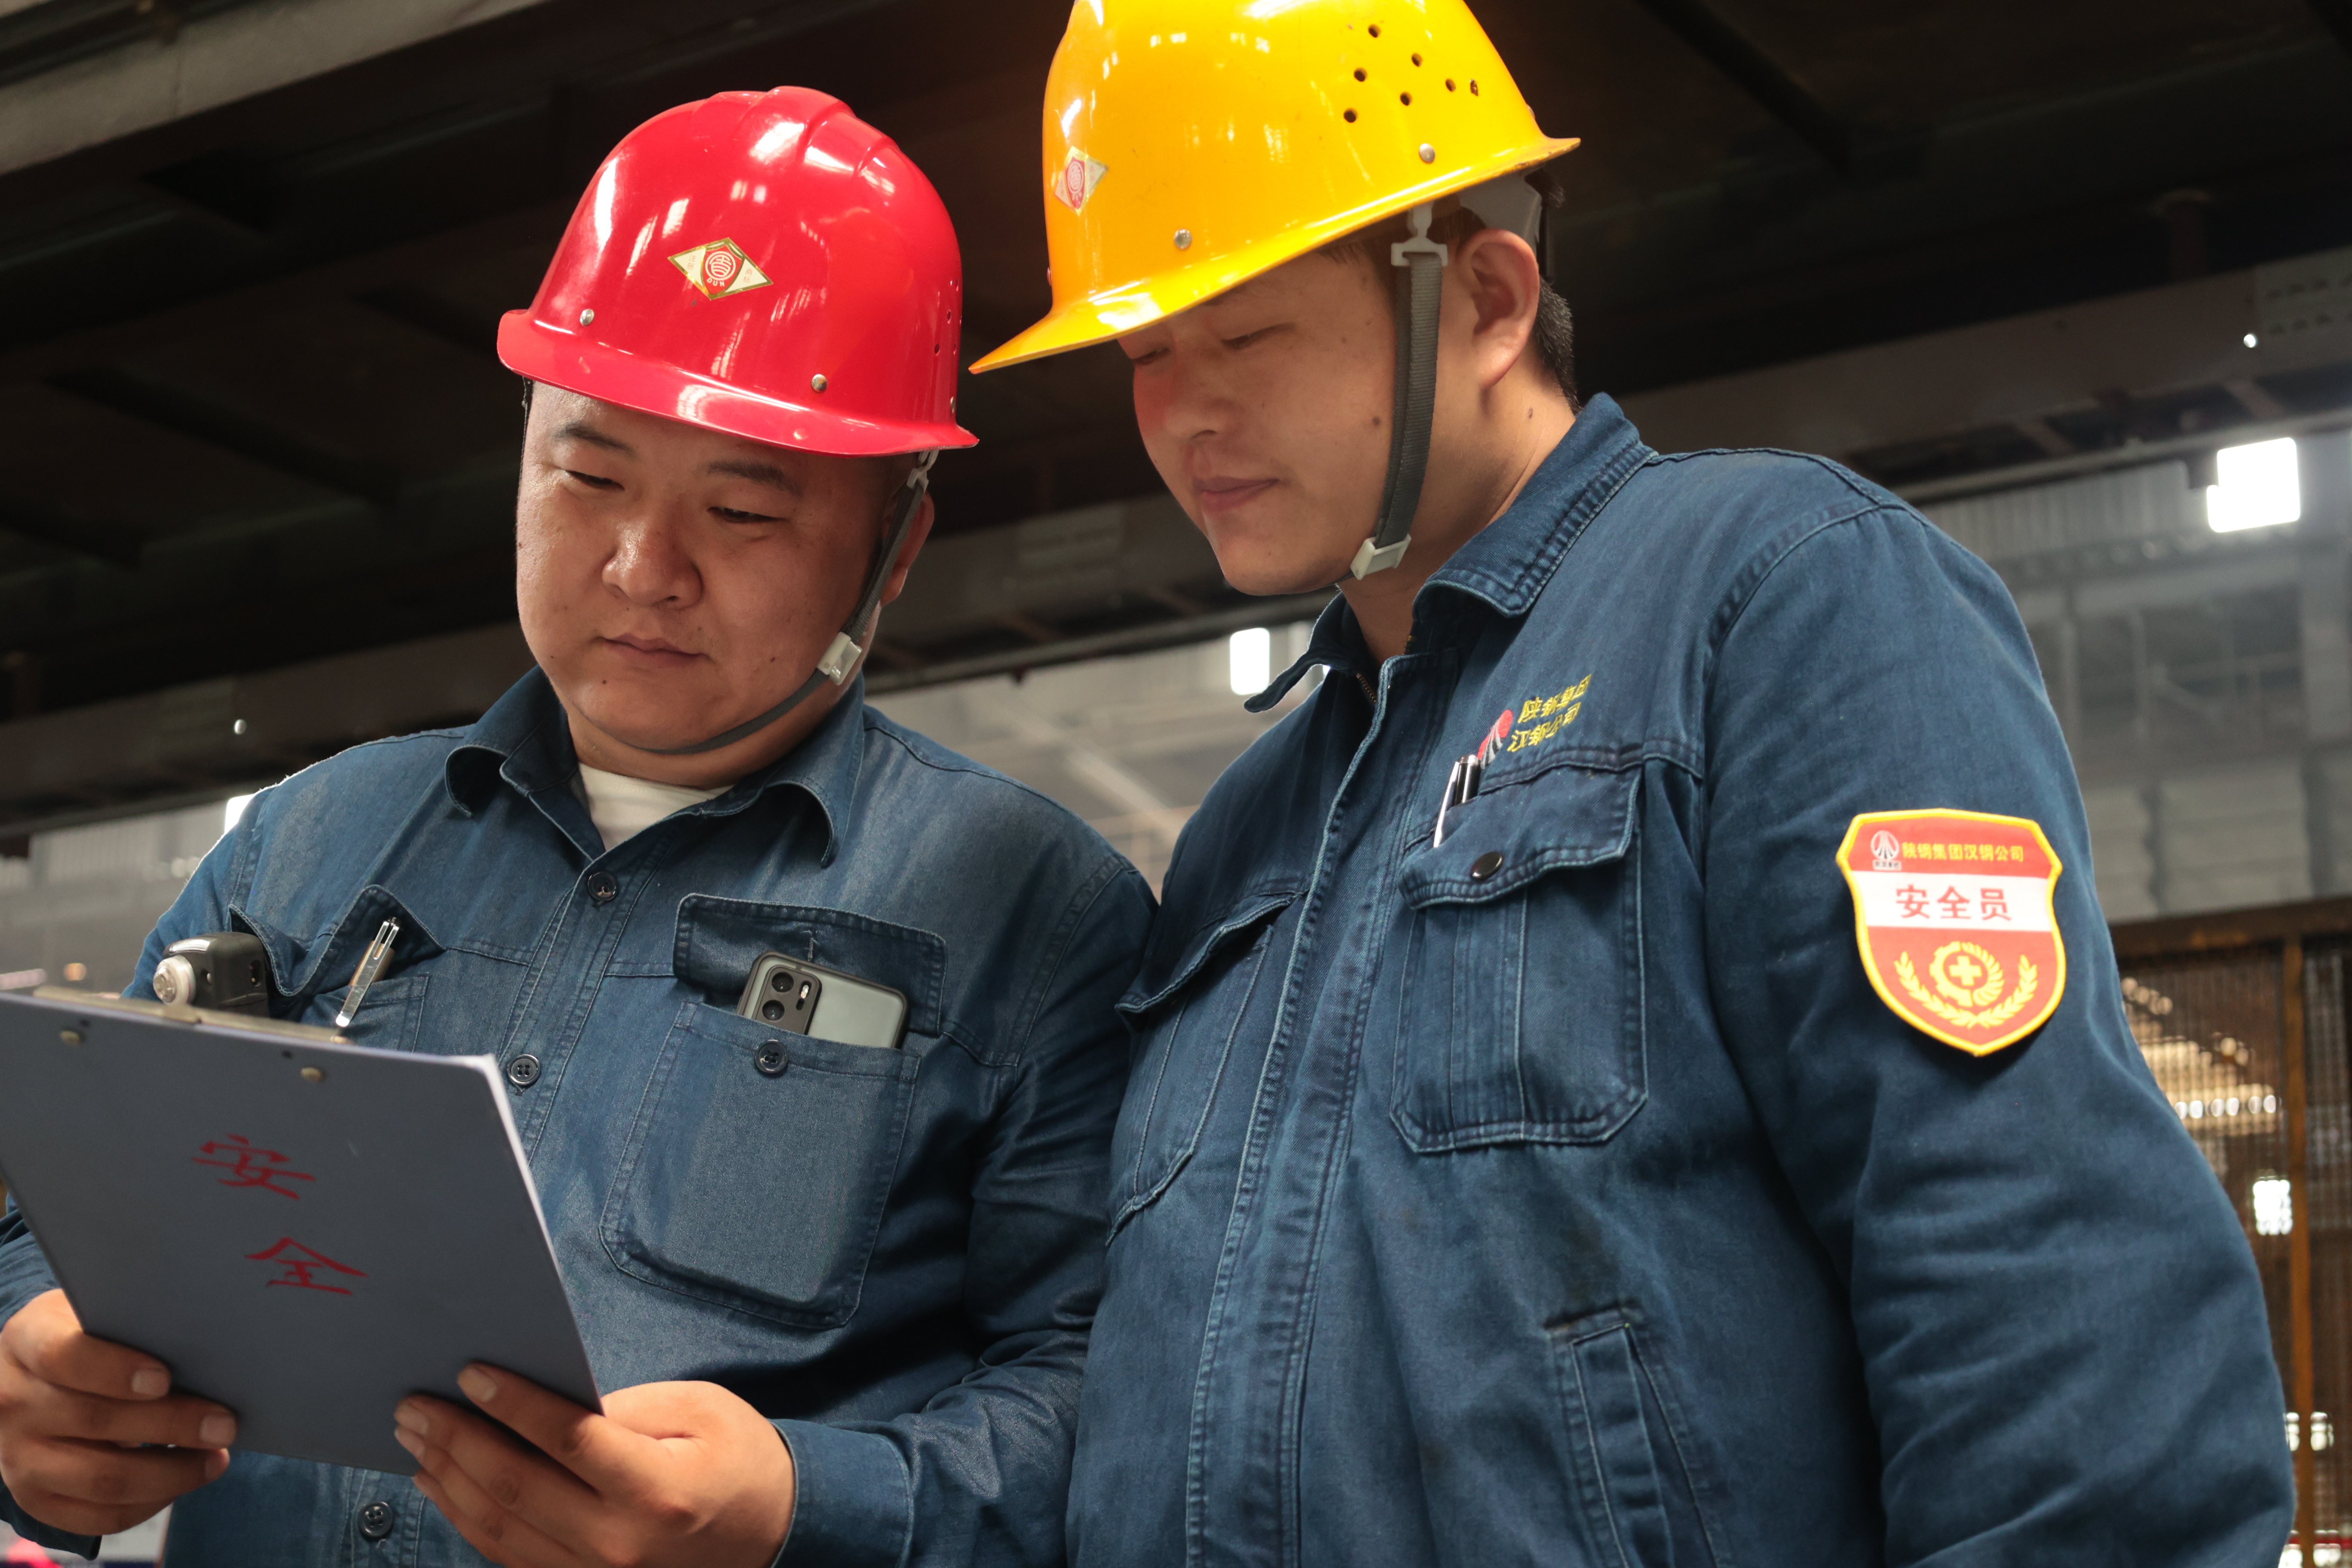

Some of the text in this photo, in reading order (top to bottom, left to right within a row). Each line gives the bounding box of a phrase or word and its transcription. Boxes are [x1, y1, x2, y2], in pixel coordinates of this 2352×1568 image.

[706, 277, 725, 287] DUN
[1901, 841, 2024, 863] 陕钢集团汉钢公司
[1896, 884, 2012, 922] 安全员
[191, 1132, 369, 1296] 安全
